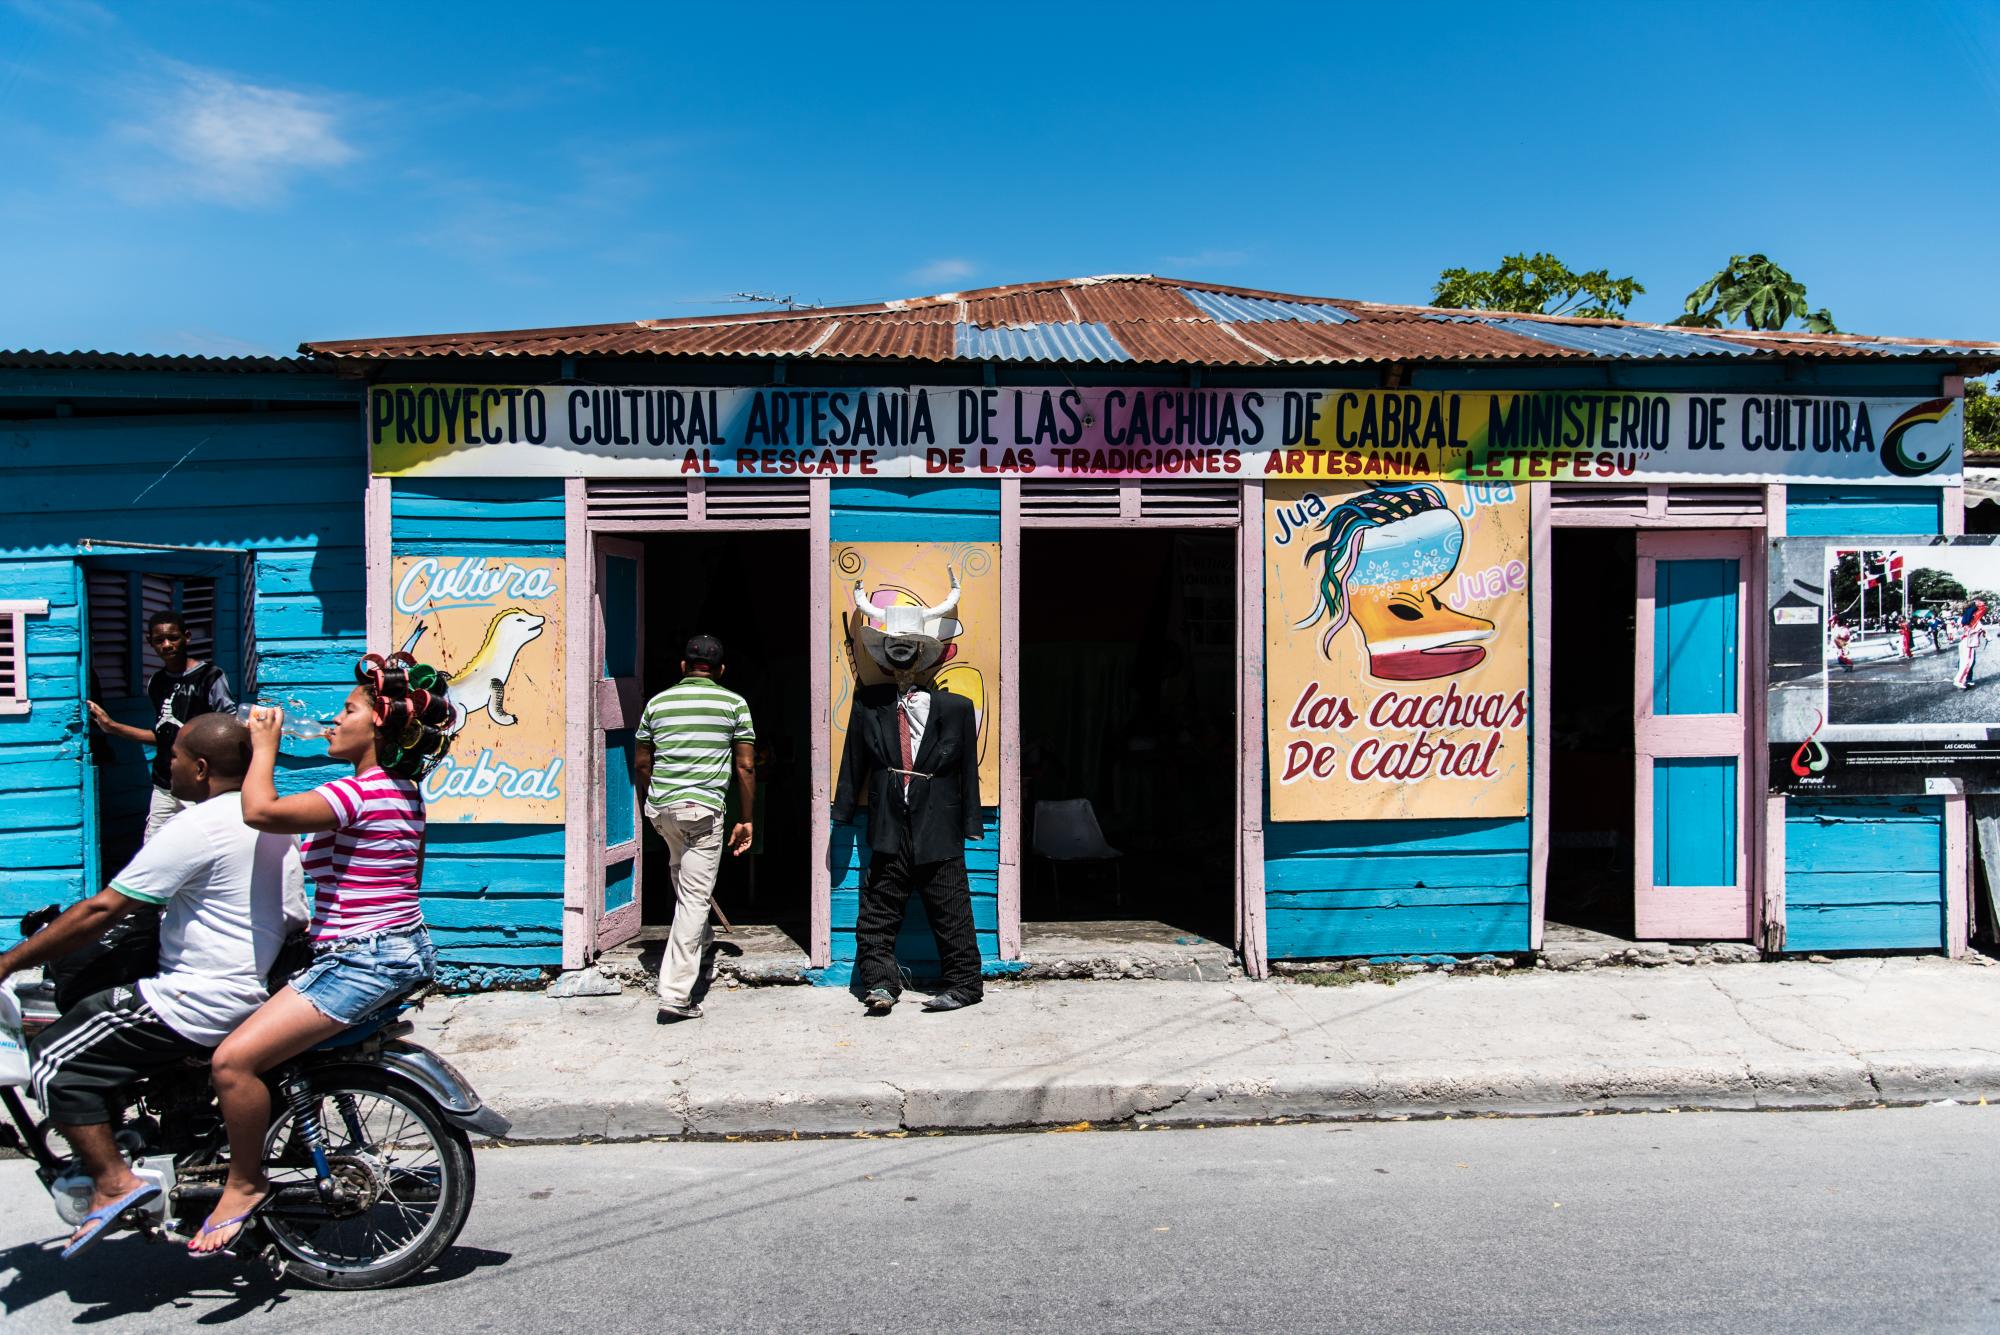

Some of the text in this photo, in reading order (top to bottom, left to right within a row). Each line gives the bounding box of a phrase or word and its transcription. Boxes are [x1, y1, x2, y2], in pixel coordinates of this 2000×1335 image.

[372, 388, 1875, 454] PROYECTO CULTURAL ARTESANIA DE LAS CACHUAS DE CABRAL MINISTERIO DE CULTURA
[681, 448, 720, 475] AL
[736, 448, 878, 475] RESCATE
[926, 448, 965, 475] DE
[980, 448, 1037, 474] LAS
[1050, 448, 1242, 475] TRADICIONES
[1263, 448, 1432, 476] ARTESANIA
[1274, 492, 1327, 545] Jua
[395, 557, 556, 615] Cultura
[1450, 561, 1525, 608] Juae
[1350, 732, 1499, 780] Cabral
